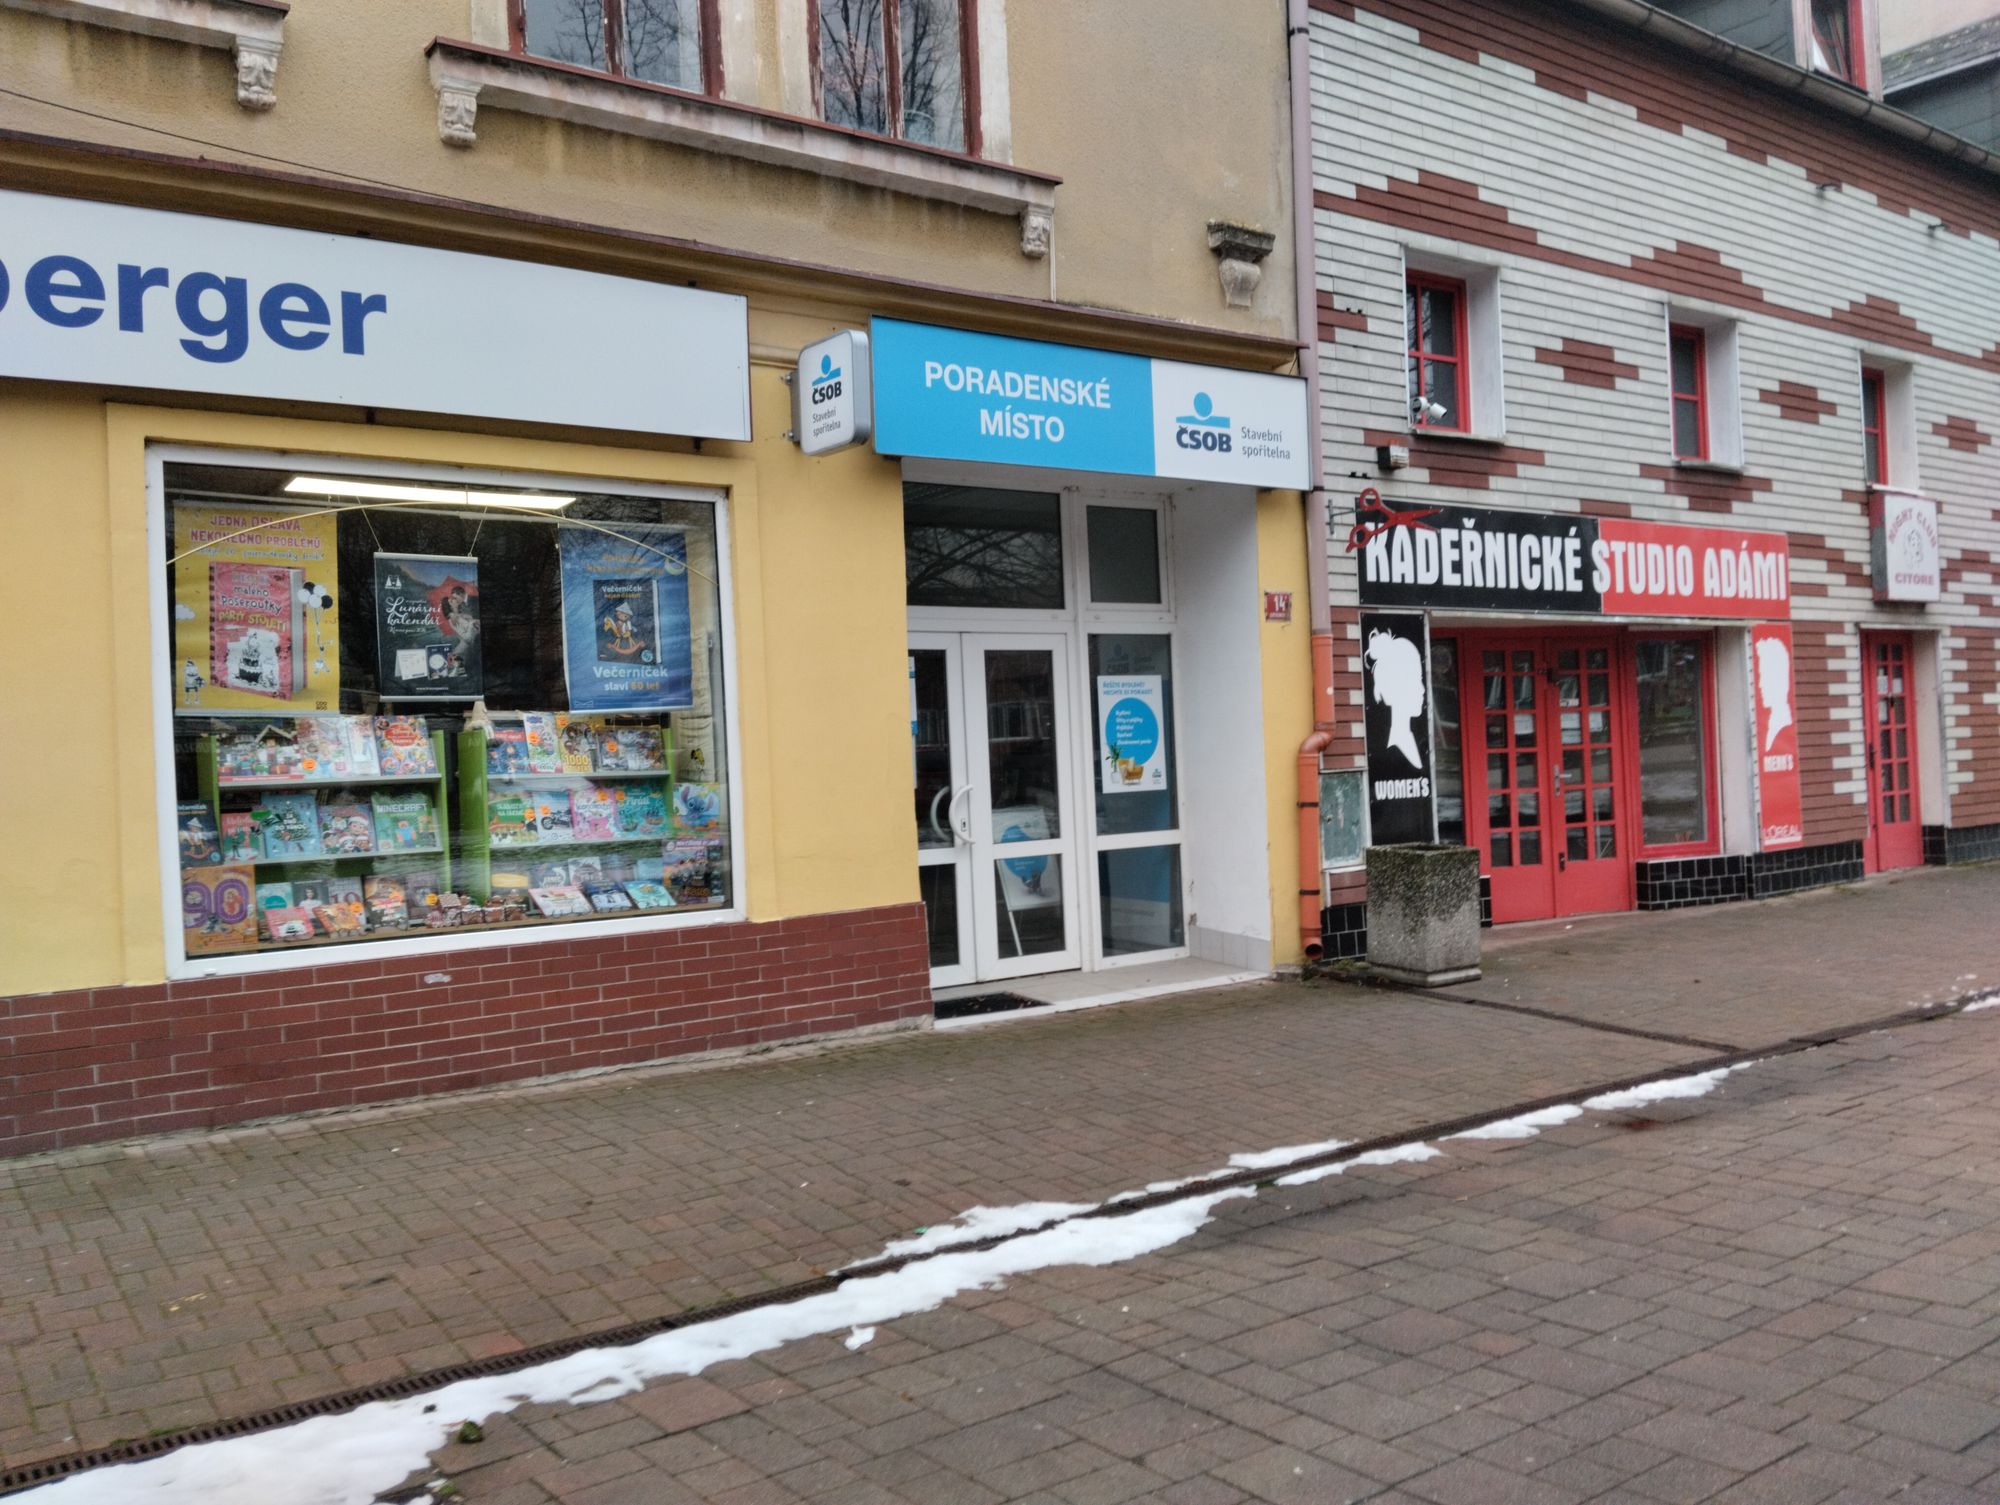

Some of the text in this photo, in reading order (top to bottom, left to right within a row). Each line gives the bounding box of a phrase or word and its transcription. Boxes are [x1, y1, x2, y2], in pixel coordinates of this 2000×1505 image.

[925, 360, 1111, 408] PORADENSKÉ
[812, 380, 842, 405] ČSOB
[812, 406, 837, 423] Stavební
[812, 420, 841, 437] spořitelna
[980, 405, 1065, 442] MÍSTO
[1176, 424, 1232, 453] ČSOB
[1241, 426, 1282, 442] Stavební
[1242, 444, 1291, 459] spořitelna
[210, 515, 247, 528] JEDNA
[1365, 518, 1787, 601] KADEŘNICKÉ STUDIO ADÁMI
[593, 665, 668, 679] Večerníček
[604, 680, 629, 691] slaví
[564, 754, 589, 766] 1000
[377, 803, 428, 813] MINECRAFT
